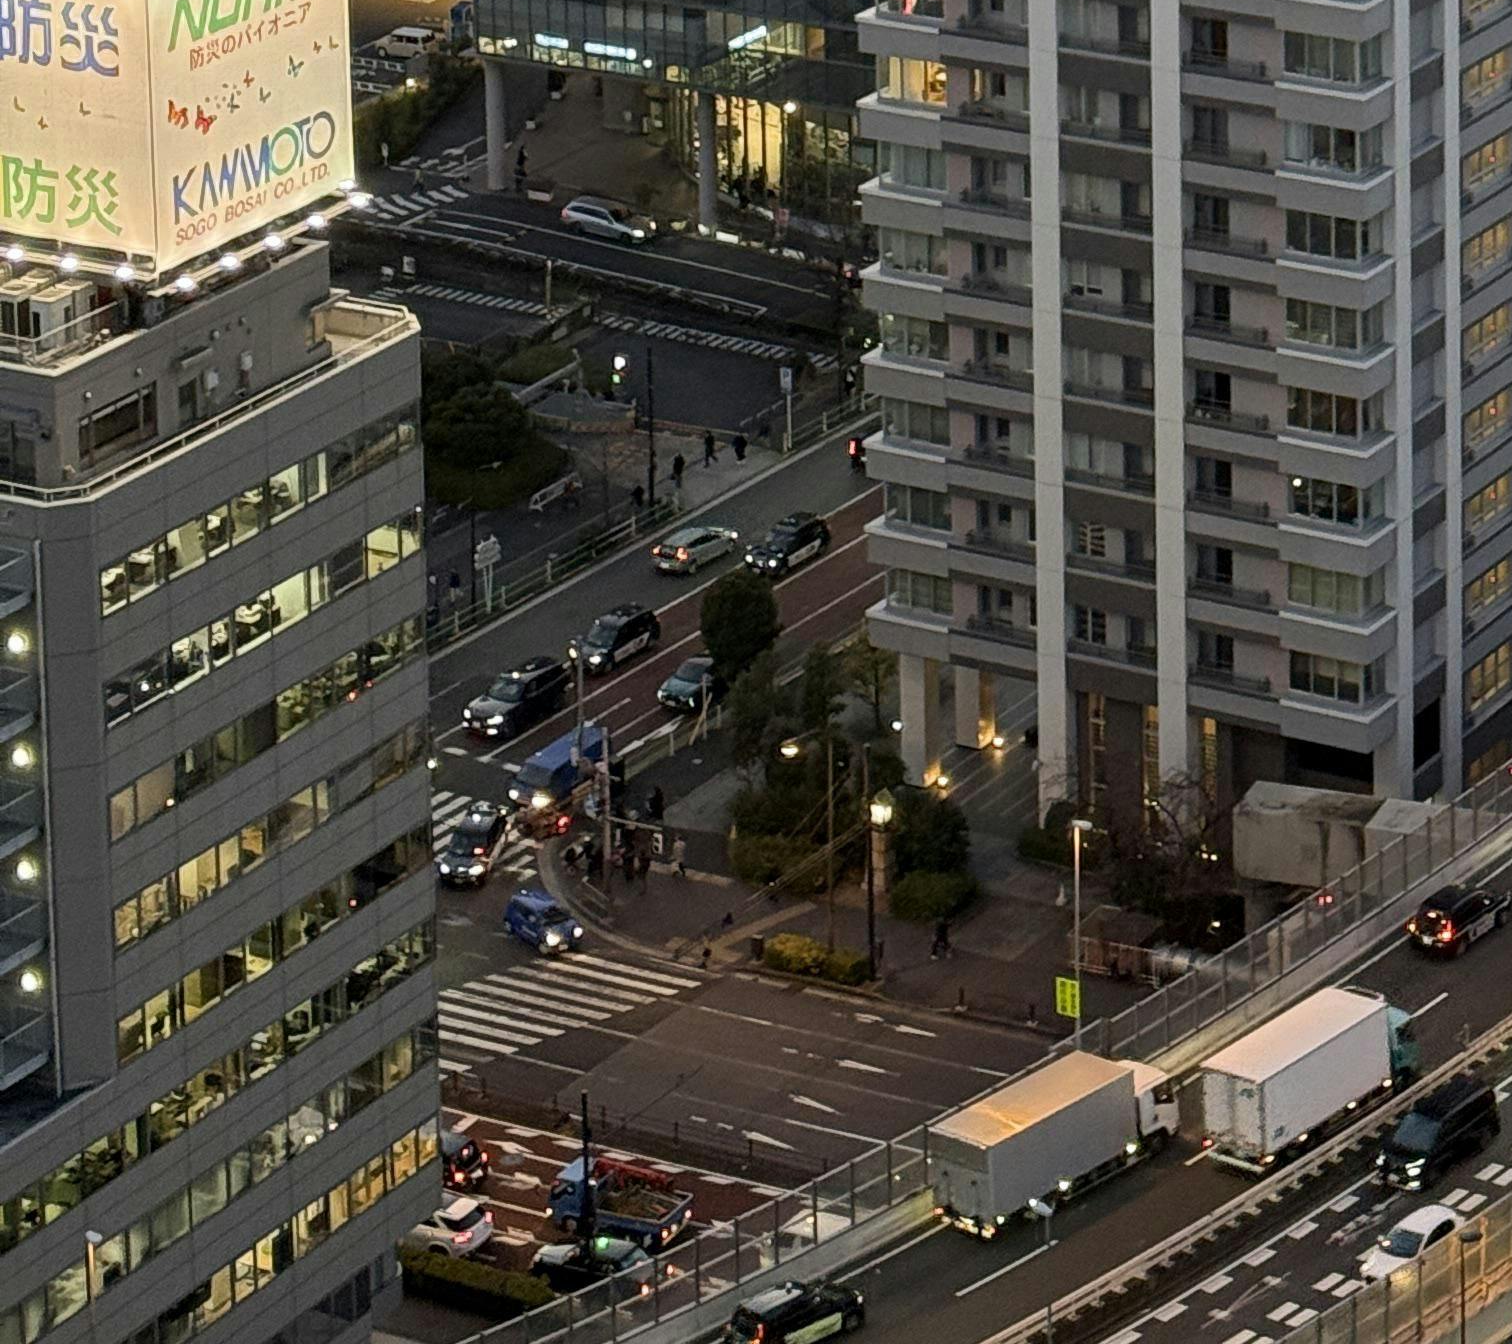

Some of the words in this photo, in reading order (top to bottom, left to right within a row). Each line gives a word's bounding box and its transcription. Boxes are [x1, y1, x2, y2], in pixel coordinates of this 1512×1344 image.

[0, 154, 122, 236] 防災
[175, 213, 218, 246] SOGO
[224, 190, 267, 224] BOSAI
